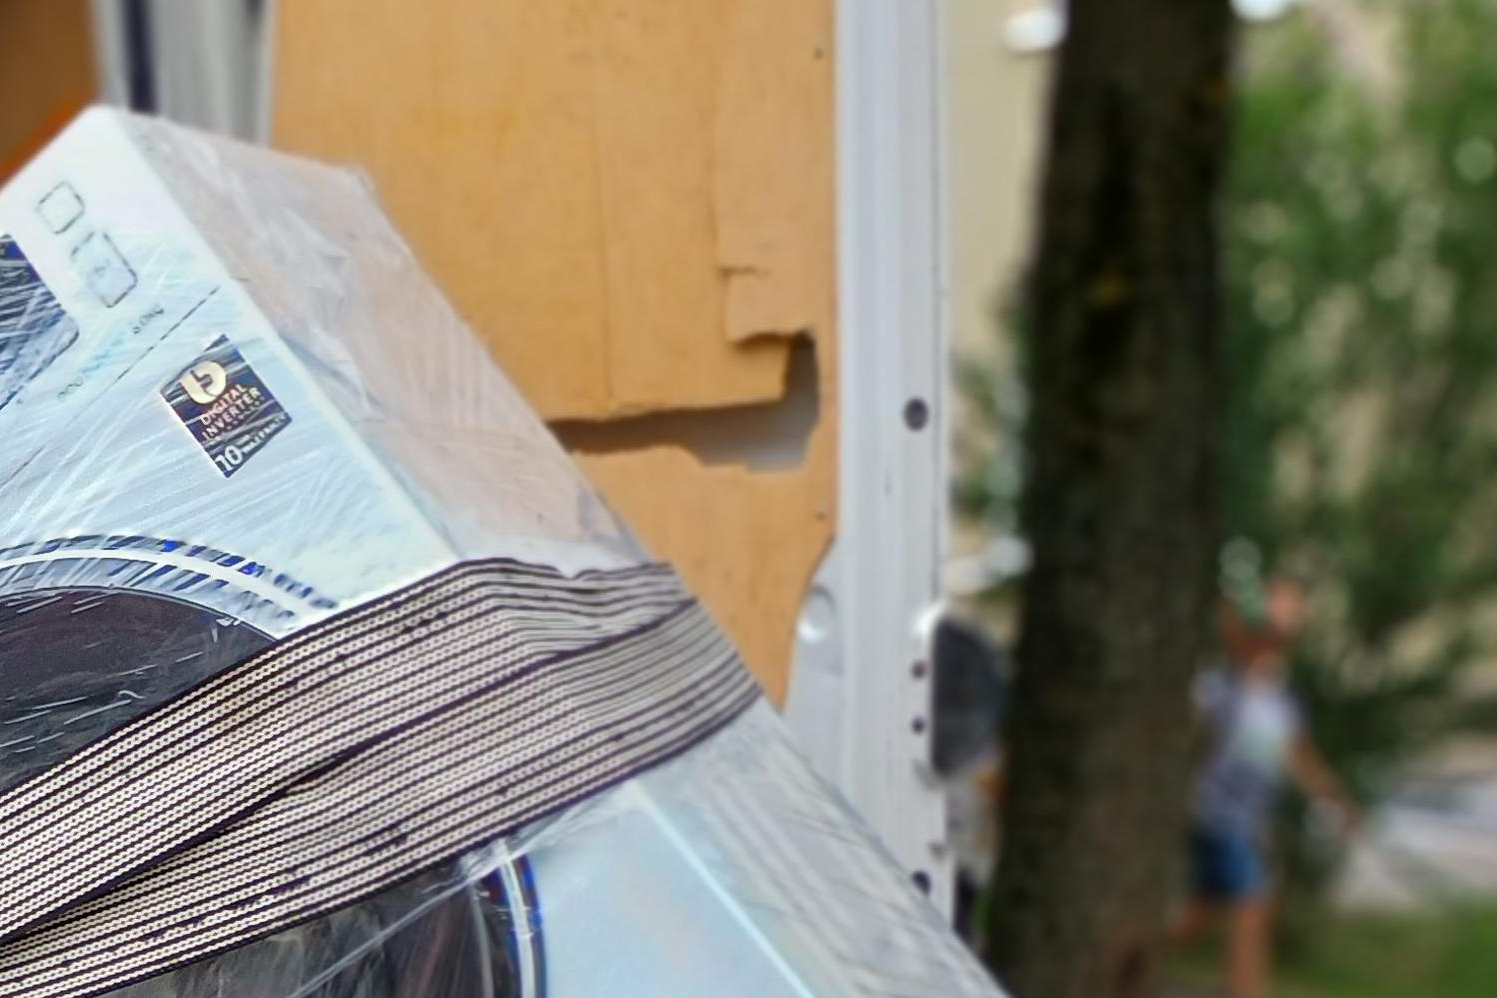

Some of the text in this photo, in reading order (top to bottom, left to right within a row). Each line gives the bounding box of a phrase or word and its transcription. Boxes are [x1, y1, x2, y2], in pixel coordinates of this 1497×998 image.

[199, 383, 248, 426] DIGITAL
[202, 387, 261, 441] INVERTER
[214, 444, 243, 471] 10
